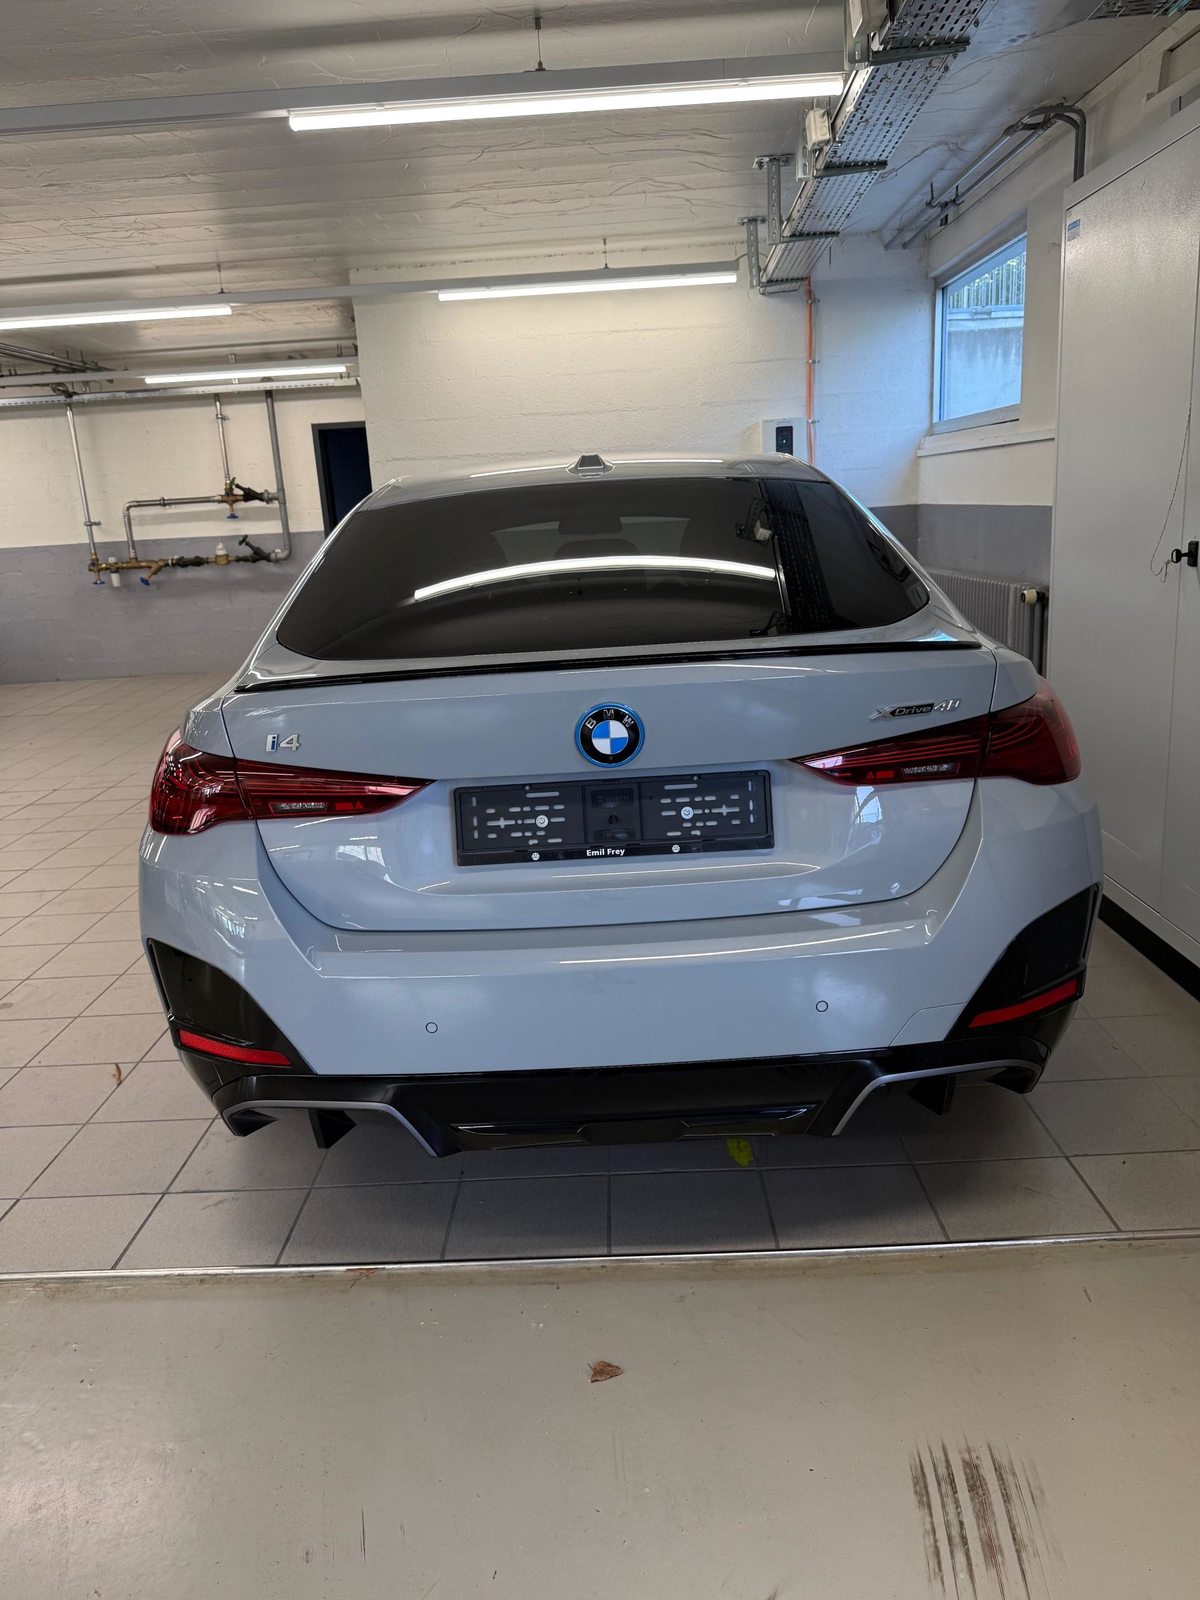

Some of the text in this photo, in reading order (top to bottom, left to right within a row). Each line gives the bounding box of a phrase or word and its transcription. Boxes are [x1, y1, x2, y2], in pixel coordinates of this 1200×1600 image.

[585, 709, 635, 729] BMW
[265, 734, 301, 752] i4
[586, 848, 626, 857] Emil Frey
